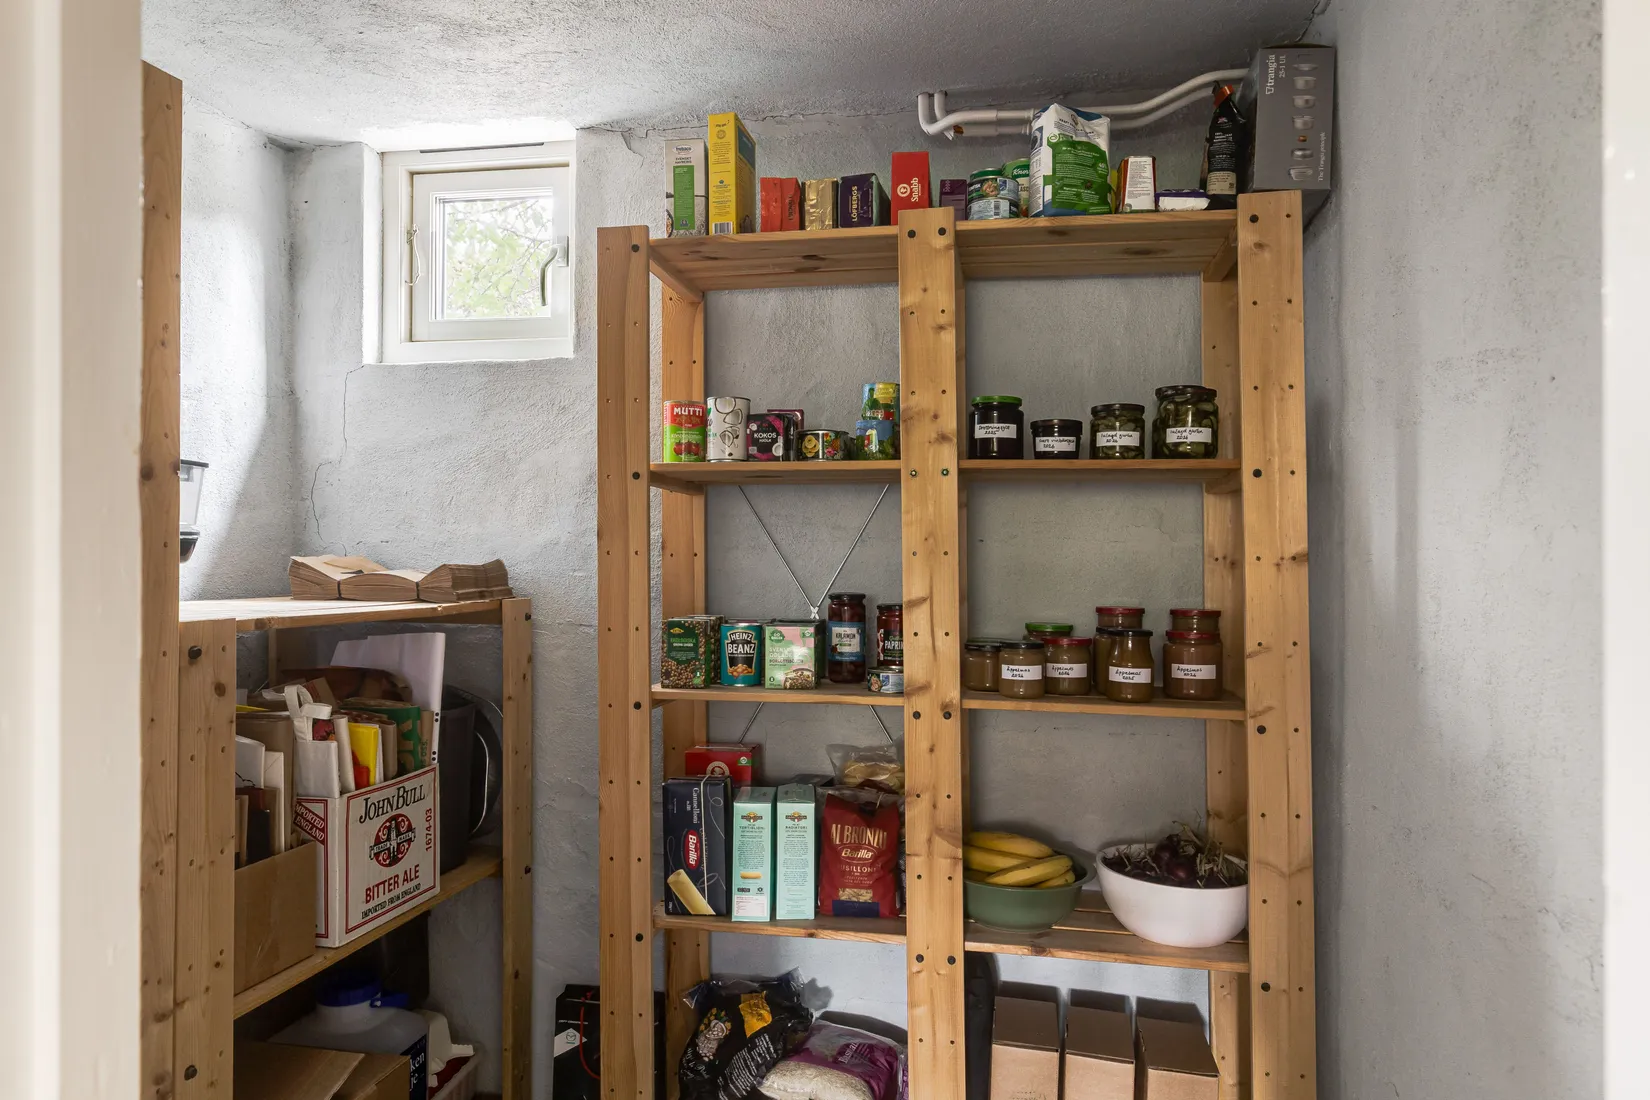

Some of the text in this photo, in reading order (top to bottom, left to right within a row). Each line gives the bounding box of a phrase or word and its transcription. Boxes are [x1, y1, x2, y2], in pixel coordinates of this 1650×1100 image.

[1266, 54, 1278, 86] trangia
[1013, 168, 1030, 176] Knor
[911, 177, 919, 202] Snabb
[673, 407, 703, 416] MUTTI
[730, 632, 752, 641] HEINZ
[728, 643, 755, 653] BEANZ
[359, 784, 426, 824] JOHN BULL
[692, 787, 700, 824] Cannelloni
[295, 816, 325, 841] ENGLAND
[831, 823, 841, 845] AL
[375, 842, 389, 852] TRADE
[688, 834, 697, 866] Barilla
[841, 848, 874, 859] Barilla
[365, 863, 420, 905] BITTER ALE
[361, 882, 422, 920] IMPORTED FROM ENGLAND
[410, 1052, 425, 1072] ken
[410, 1072, 419, 1092] je
